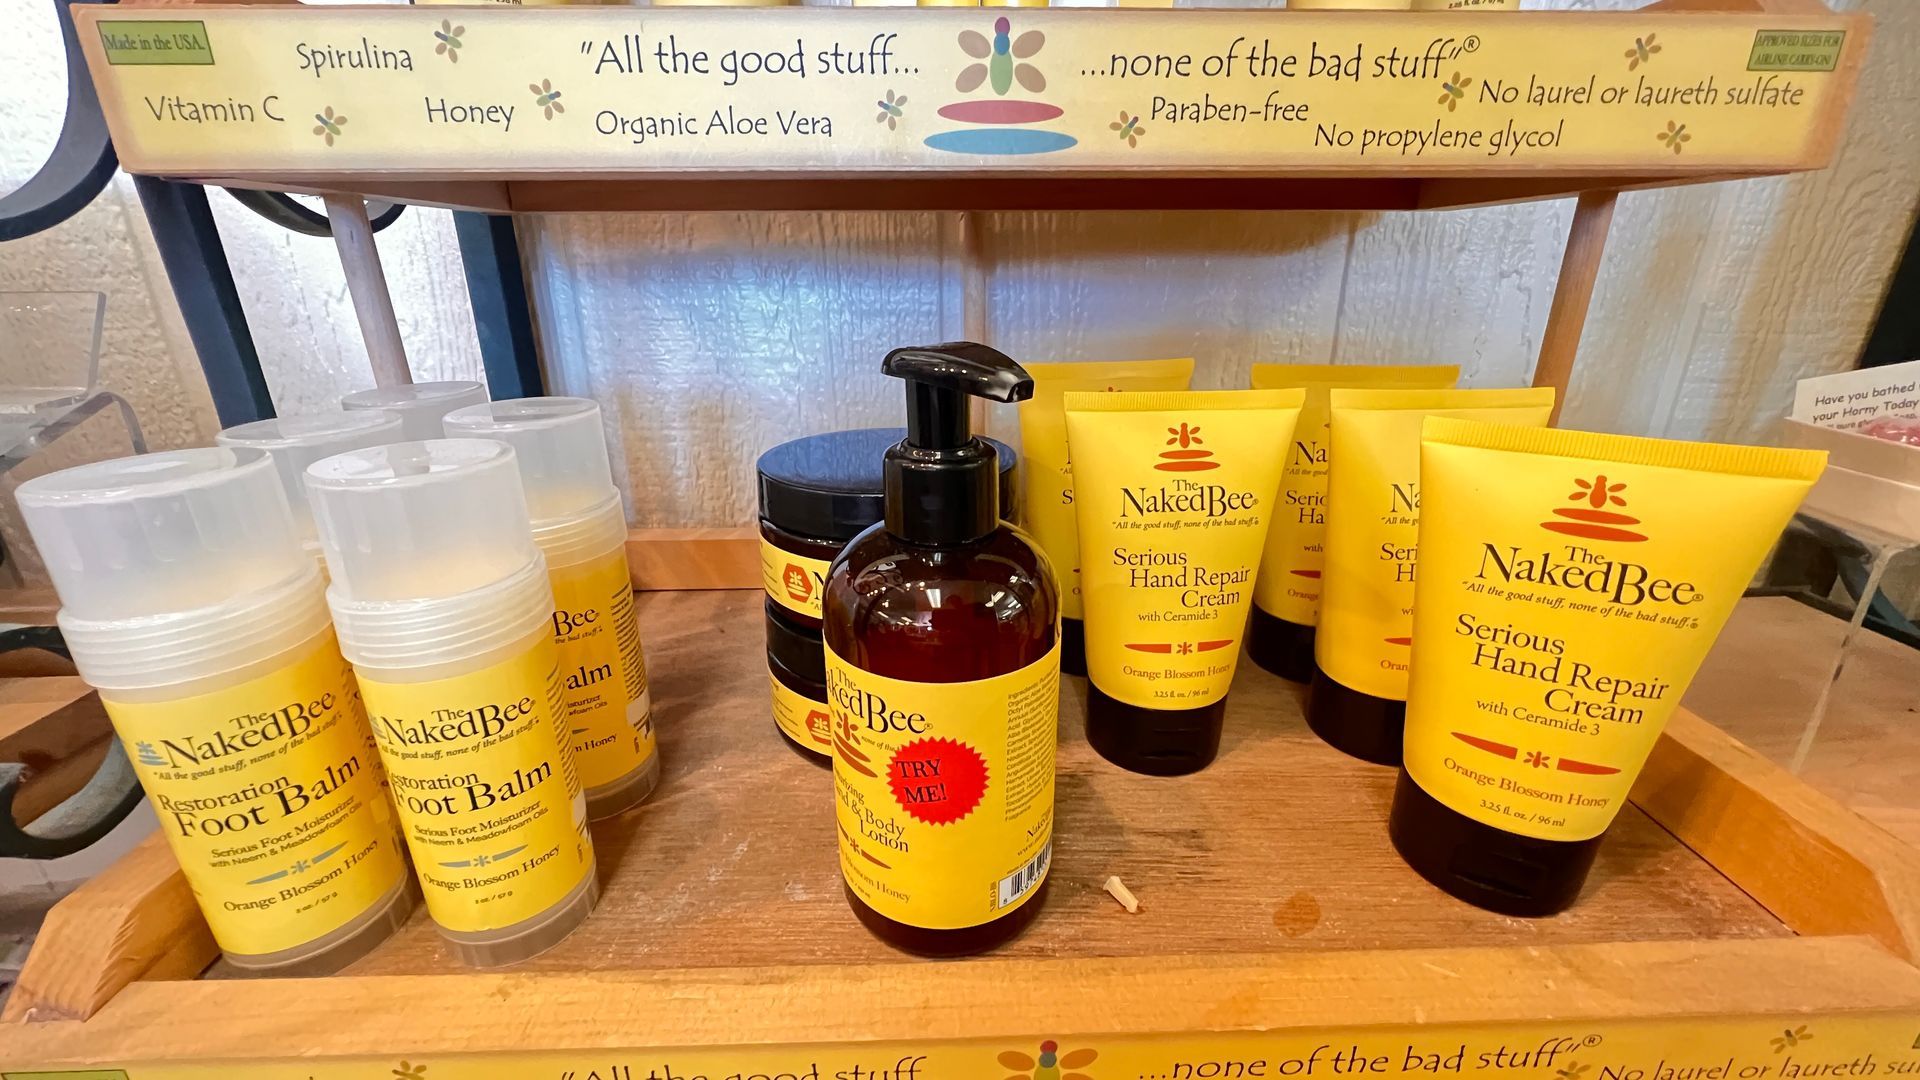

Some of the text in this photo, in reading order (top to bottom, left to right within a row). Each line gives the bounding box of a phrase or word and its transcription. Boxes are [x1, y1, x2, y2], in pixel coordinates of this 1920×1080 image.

[104, 34, 138, 50] Made
[138, 34, 152, 50] in
[153, 34, 172, 50] the
[297, 38, 413, 77] Spirulina
[653, 35, 709, 75] the
[720, 39, 806, 86] good
[1202, 37, 1245, 78] of
[1246, 39, 1297, 78] the
[1308, 42, 1362, 82] bad
[1479, 74, 1804, 107] No laurel or laureth sulfate
[145, 96, 284, 122] Vitamin C
[425, 97, 514, 131] Honey
[1150, 91, 1309, 123] Paraben-free
[595, 105, 832, 144] Organic Aloe Vera
[1314, 119, 1564, 156] No propylene glycol
[1815, 381, 1916, 406] Have you bathed
[1812, 411, 1839, 424] your
[1842, 405, 1879, 418] Horny
[1883, 399, 1920, 411] Today
[1172, 479, 1198, 491] The
[1130, 521, 1142, 529] the
[1143, 521, 1161, 531] good
[1163, 520, 1182, 531] stuff,
[1202, 518, 1211, 529] of
[1212, 518, 1223, 527] the
[1224, 517, 1236, 526] bad
[1298, 507, 1324, 524] Ha
[1399, 516, 1410, 525] the
[1113, 548, 1187, 566] Serious
[1303, 543, 1323, 553] with
[1564, 545, 1604, 565] The
[1130, 565, 1251, 592] Hand Repair
[1181, 590, 1240, 608] Cream
[1487, 583, 1504, 597] the
[1506, 588, 1532, 601] good
[1536, 592, 1565, 609] stuff,
[1569, 601, 1598, 613] none
[1600, 604, 1614, 618] of
[1615, 607, 1633, 619] the
[1635, 608, 1659, 623] bad
[1138, 609, 1218, 622] with Ceramide 3
[1455, 613, 1565, 655] Serious
[566, 663, 612, 690] alm
[836, 667, 856, 691] The
[1123, 663, 1231, 680] Orange Blossom Honey
[1380, 659, 1408, 671] Oran
[1471, 642, 1670, 704] Hand Repair
[1193, 689, 1201, 697] 96
[1202, 688, 1209, 696] ml
[1544, 688, 1643, 724] Cream
[229, 713, 267, 730] The
[431, 708, 465, 722] The
[1476, 699, 1600, 736] with Ceramide 3
[174, 726, 321, 780] the good stuff, none of the bad
[401, 751, 418, 760] good
[446, 746, 469, 757] none
[471, 742, 481, 752] of
[483, 738, 497, 748] the
[499, 730, 514, 741] bad
[585, 733, 617, 752] Honey
[895, 759, 941, 779] TRY
[1444, 757, 1610, 809] Orange Blossom Honey
[157, 776, 290, 812] Restoration
[173, 805, 269, 837] Foot
[274, 756, 360, 818] Balm
[394, 760, 552, 816] Foot Balm
[903, 783, 947, 804] ME!
[211, 795, 356, 859] Serious Foot Moisturizer
[414, 801, 541, 837] Serious Foot Moisturizer
[428, 838, 455, 846] Neem
[466, 817, 532, 844] Meadowfoam
[533, 807, 549, 819] Oils
[851, 799, 905, 840] & Body
[1480, 799, 1501, 813] 3.25
[1537, 815, 1551, 825] 96
[1552, 817, 1565, 827] ml
[209, 814, 349, 867] with Neem & Meadowfoam
[860, 819, 909, 852] Lotion
[224, 839, 378, 911] Orange Blossom Honey
[423, 843, 560, 892] Orange Blossom Honey
[876, 880, 910, 903] Honey
[1279, 1044, 1330, 1075] of
[1330, 1045, 1389, 1074] the
[1401, 1044, 1465, 1073] bad
[1598, 1064, 1643, 1080] No
[1653, 1057, 1734, 1080] laurel
[1738, 1064, 1772, 1080] or
[1779, 1054, 1876, 1080] laureth
